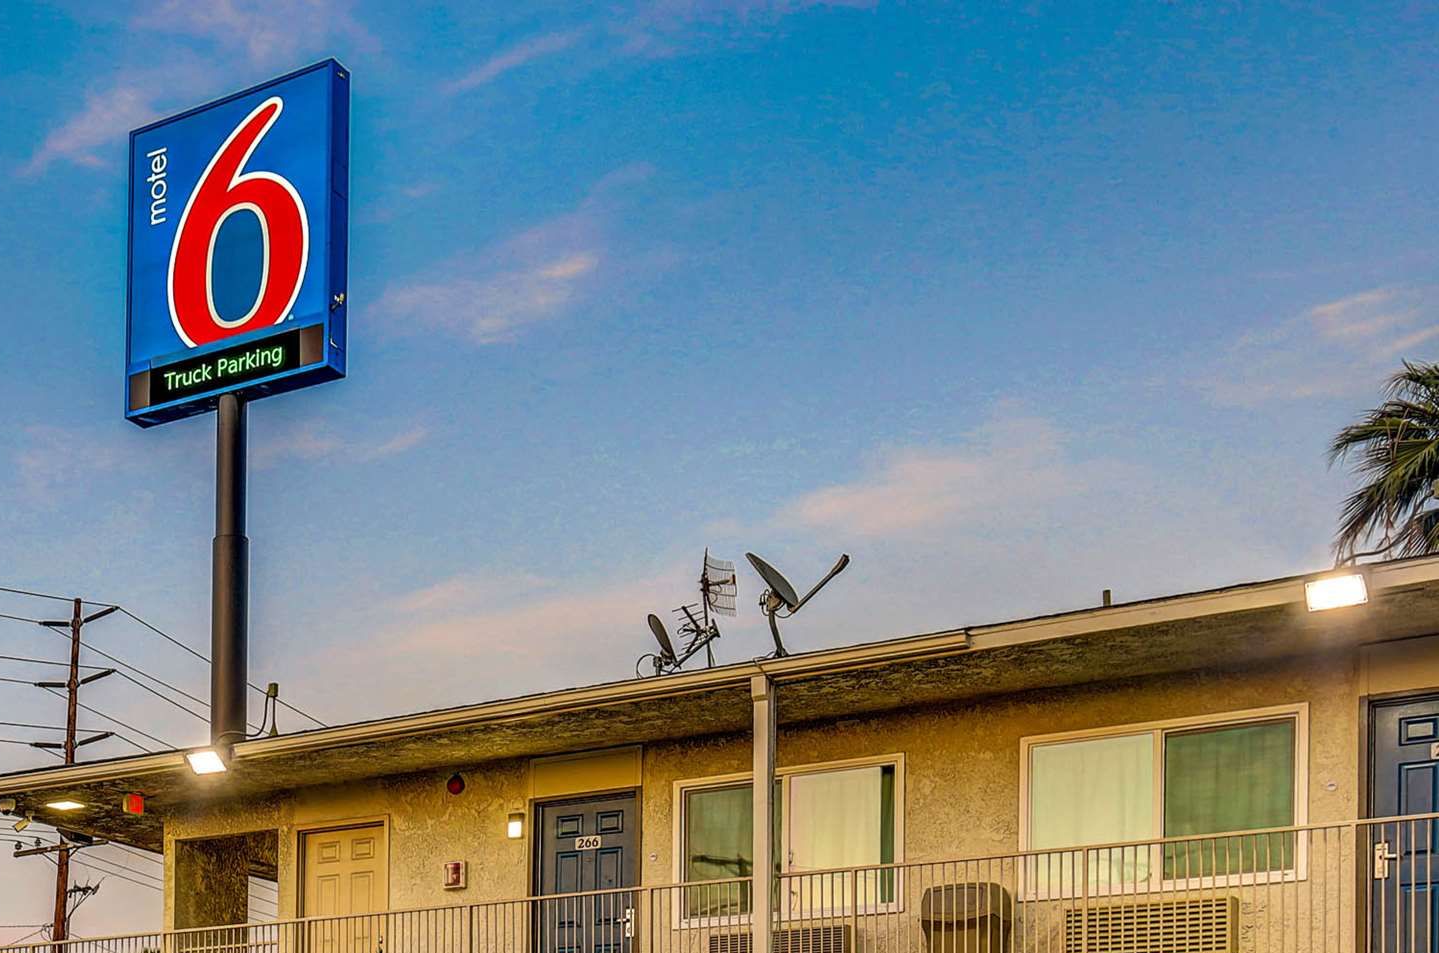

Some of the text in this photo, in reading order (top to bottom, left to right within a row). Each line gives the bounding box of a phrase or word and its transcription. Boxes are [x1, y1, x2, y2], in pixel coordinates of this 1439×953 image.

[146, 96, 309, 348] motel 6
[164, 346, 283, 390] Truck Parking
[578, 837, 599, 848] 266
